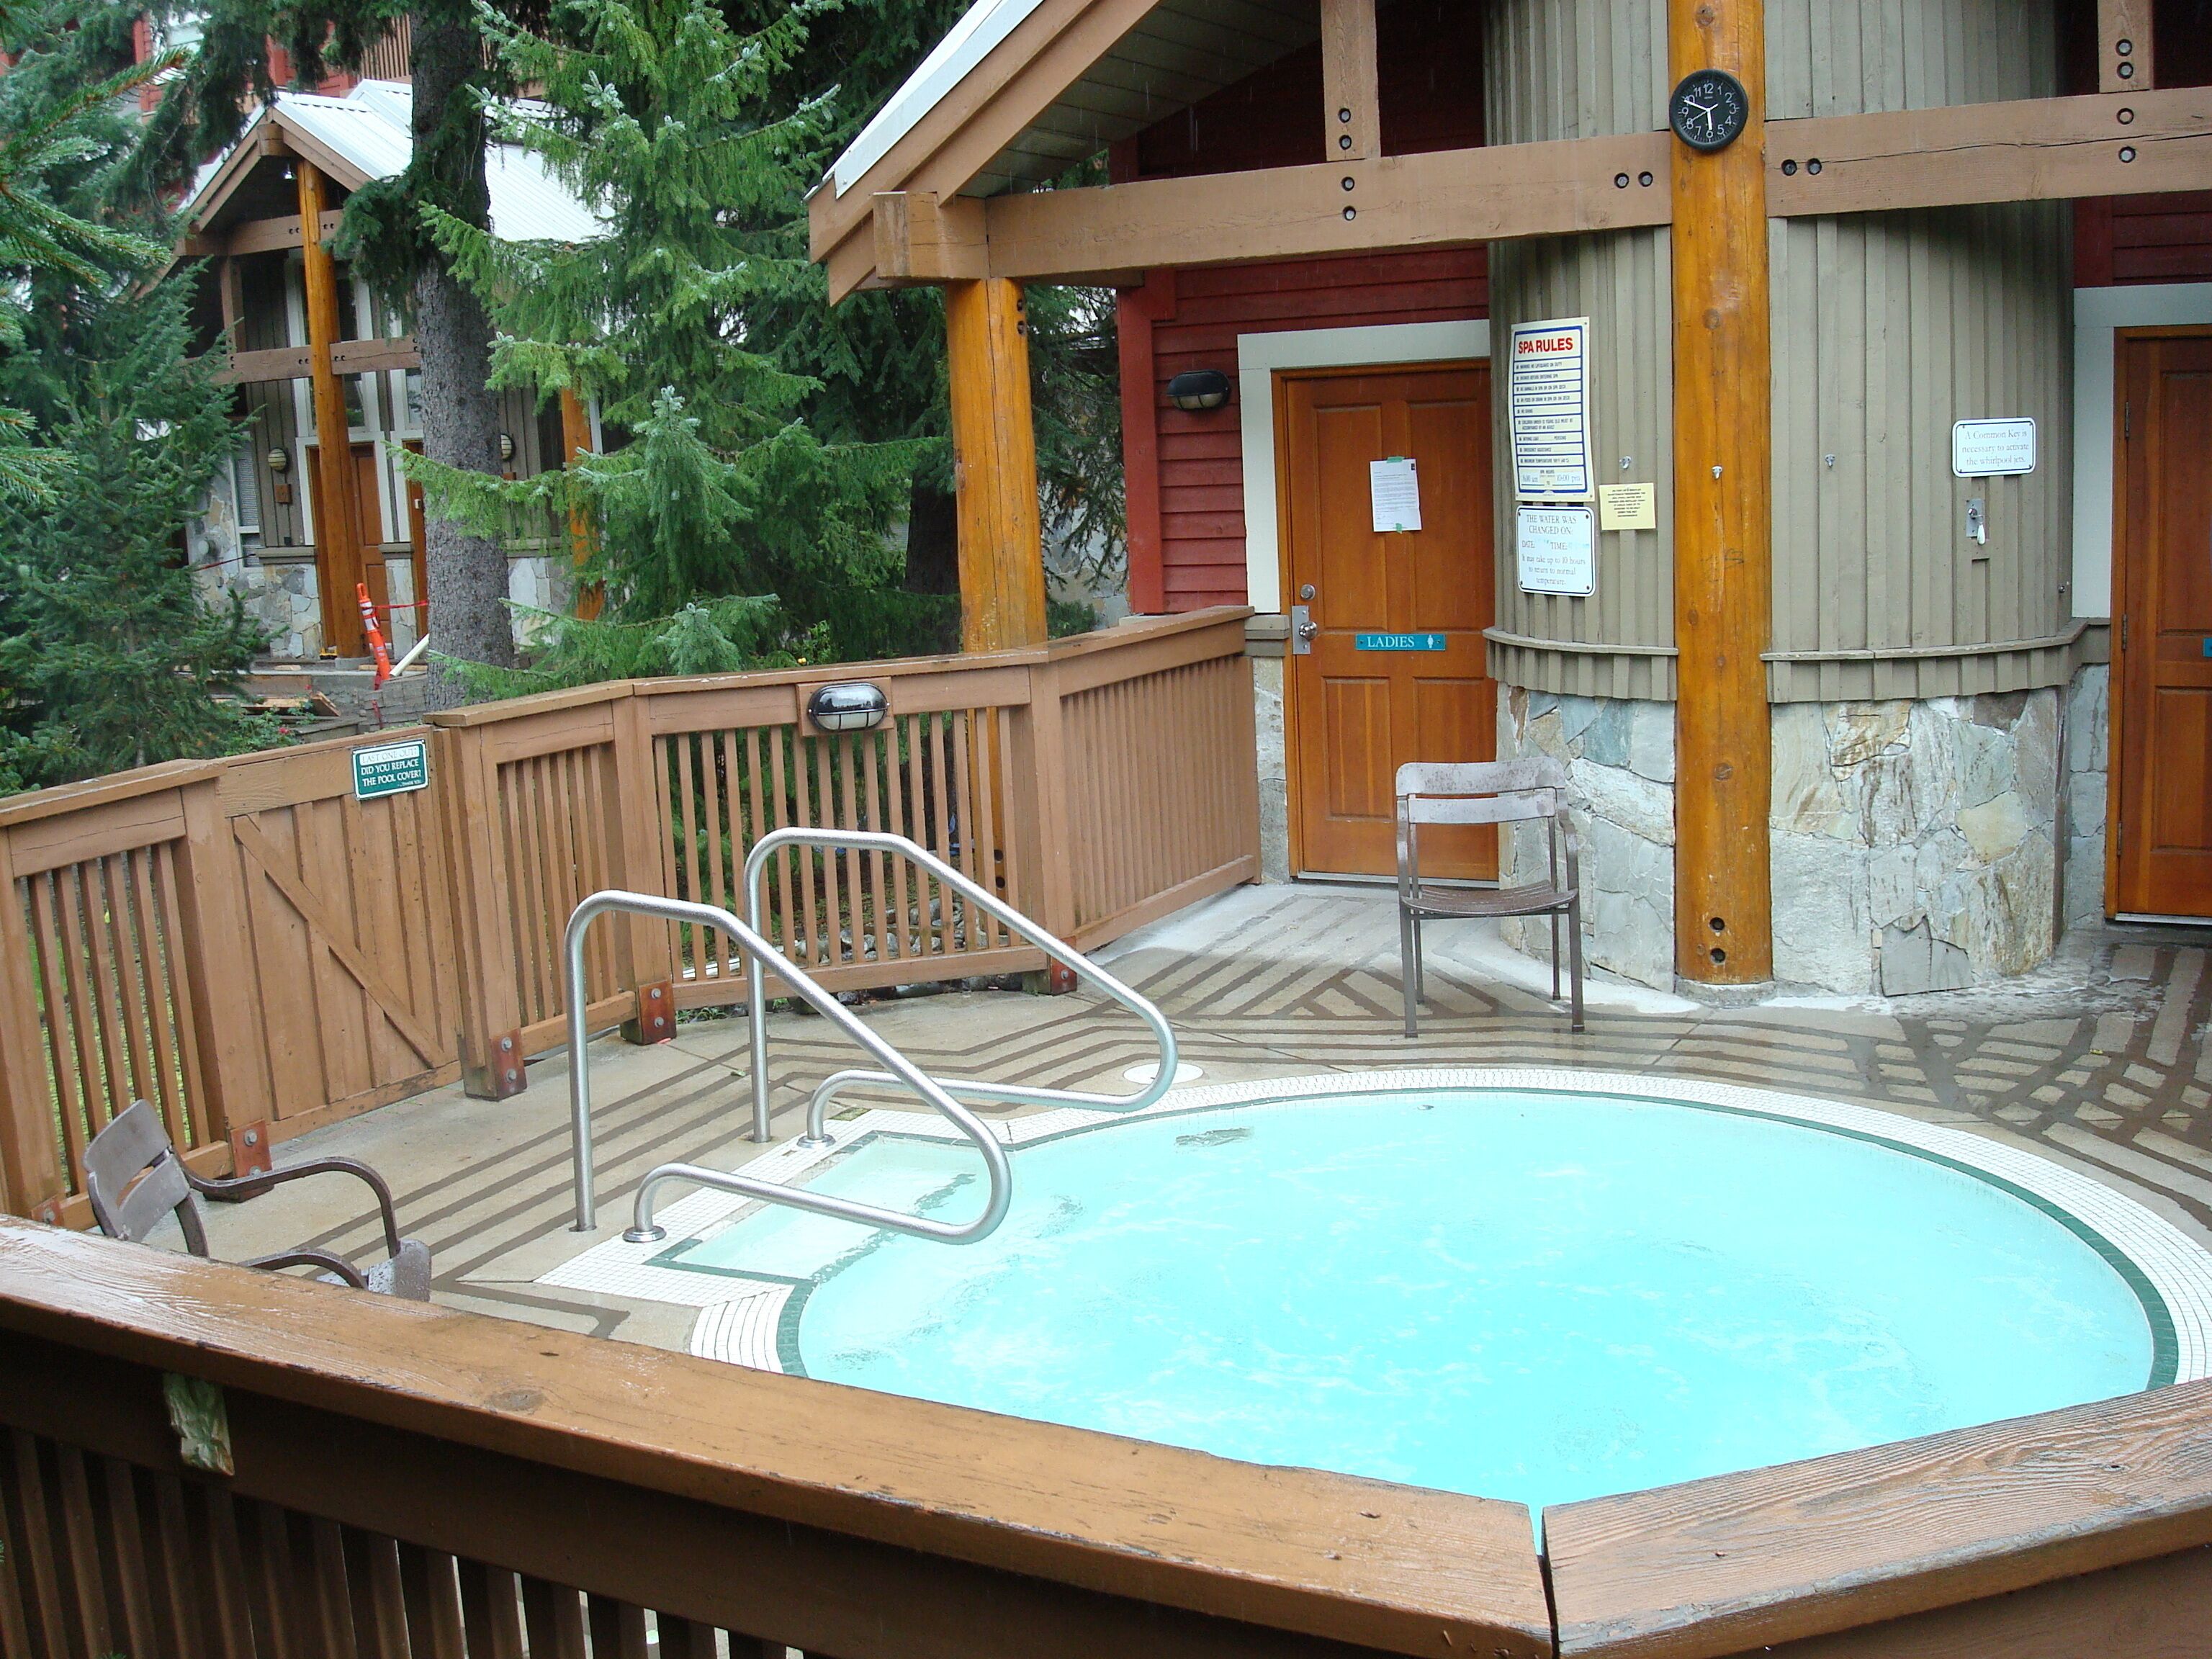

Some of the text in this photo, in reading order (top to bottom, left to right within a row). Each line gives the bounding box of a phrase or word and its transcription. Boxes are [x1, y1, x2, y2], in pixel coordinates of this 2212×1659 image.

[1694, 86, 1701, 97] 11
[1703, 83, 1714, 94] 12
[1717, 85, 1722, 95] 1
[1725, 92, 1732, 103] 2
[1681, 107, 1689, 117] 9
[1729, 103, 1737, 114] 3
[1686, 118, 1694, 130] 8
[1725, 115, 1732, 126] 4
[1695, 125, 1701, 136] 7
[1706, 130, 1713, 138] 6
[1717, 124, 1725, 135] 5
[1518, 337, 1573, 354] SPA RULES
[1964, 431, 1971, 440] A
[1973, 431, 2006, 439] Common
[2008, 429, 2021, 440] Key
[1962, 446, 1995, 454] necessary
[1966, 457, 1977, 466] the
[1979, 455, 2012, 467] whirlpool
[1526, 513, 1577, 525] THE WATER WAS
[1529, 525, 1559, 535] CHANGED
[1550, 541, 1568, 550] TIME:
[1547, 557, 1554, 565] up
[1569, 556, 1586, 565] hours
[1557, 567, 1576, 575] normal
[1367, 636, 1415, 647] LADIES
[362, 753, 381, 763] LAST
[382, 751, 398, 760] ONE
[361, 758, 419, 775] DID YOU REPLACE
[362, 770, 422, 787] THE POOL COVER?
